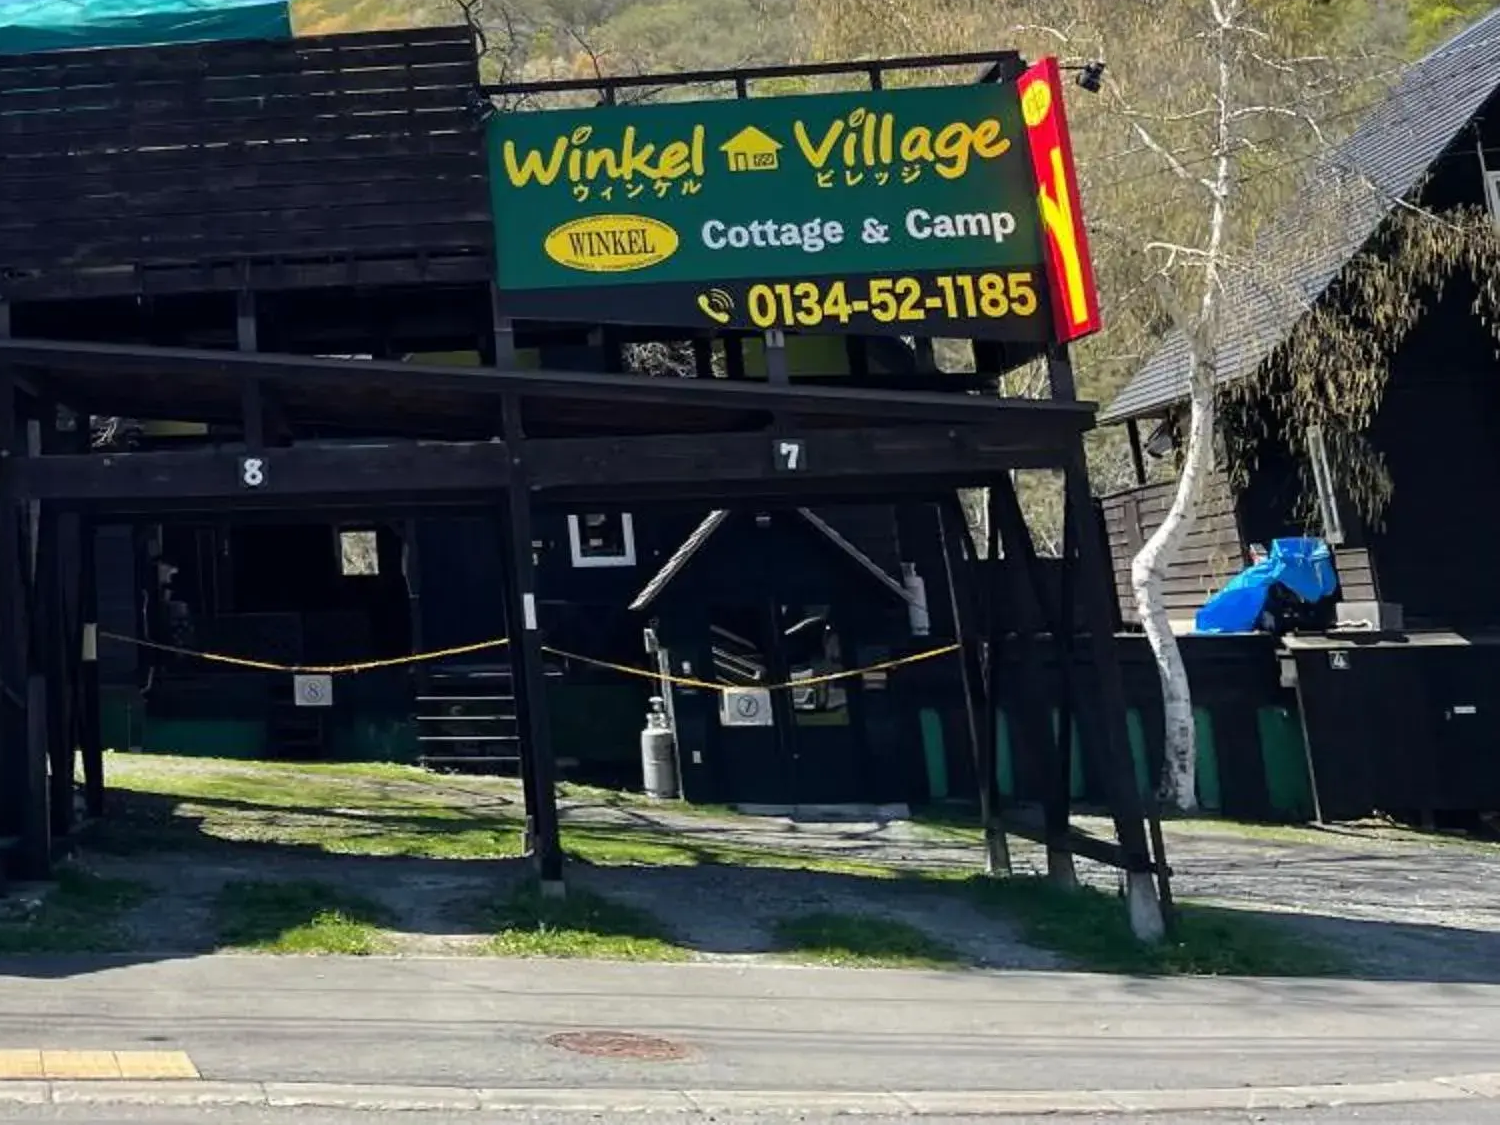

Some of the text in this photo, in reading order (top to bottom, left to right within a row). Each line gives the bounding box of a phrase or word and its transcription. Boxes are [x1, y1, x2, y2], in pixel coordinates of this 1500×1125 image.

[503, 107, 1011, 187] Winkel Village
[573, 179, 702, 202] ウィンケル
[817, 164, 921, 188] ビレッジ
[568, 228, 656, 258] WINKEL
[702, 208, 1016, 253] Cottage & Camp
[748, 272, 1037, 328] 0134-52-1185
[780, 442, 799, 470] 7
[244, 458, 263, 486] 8
